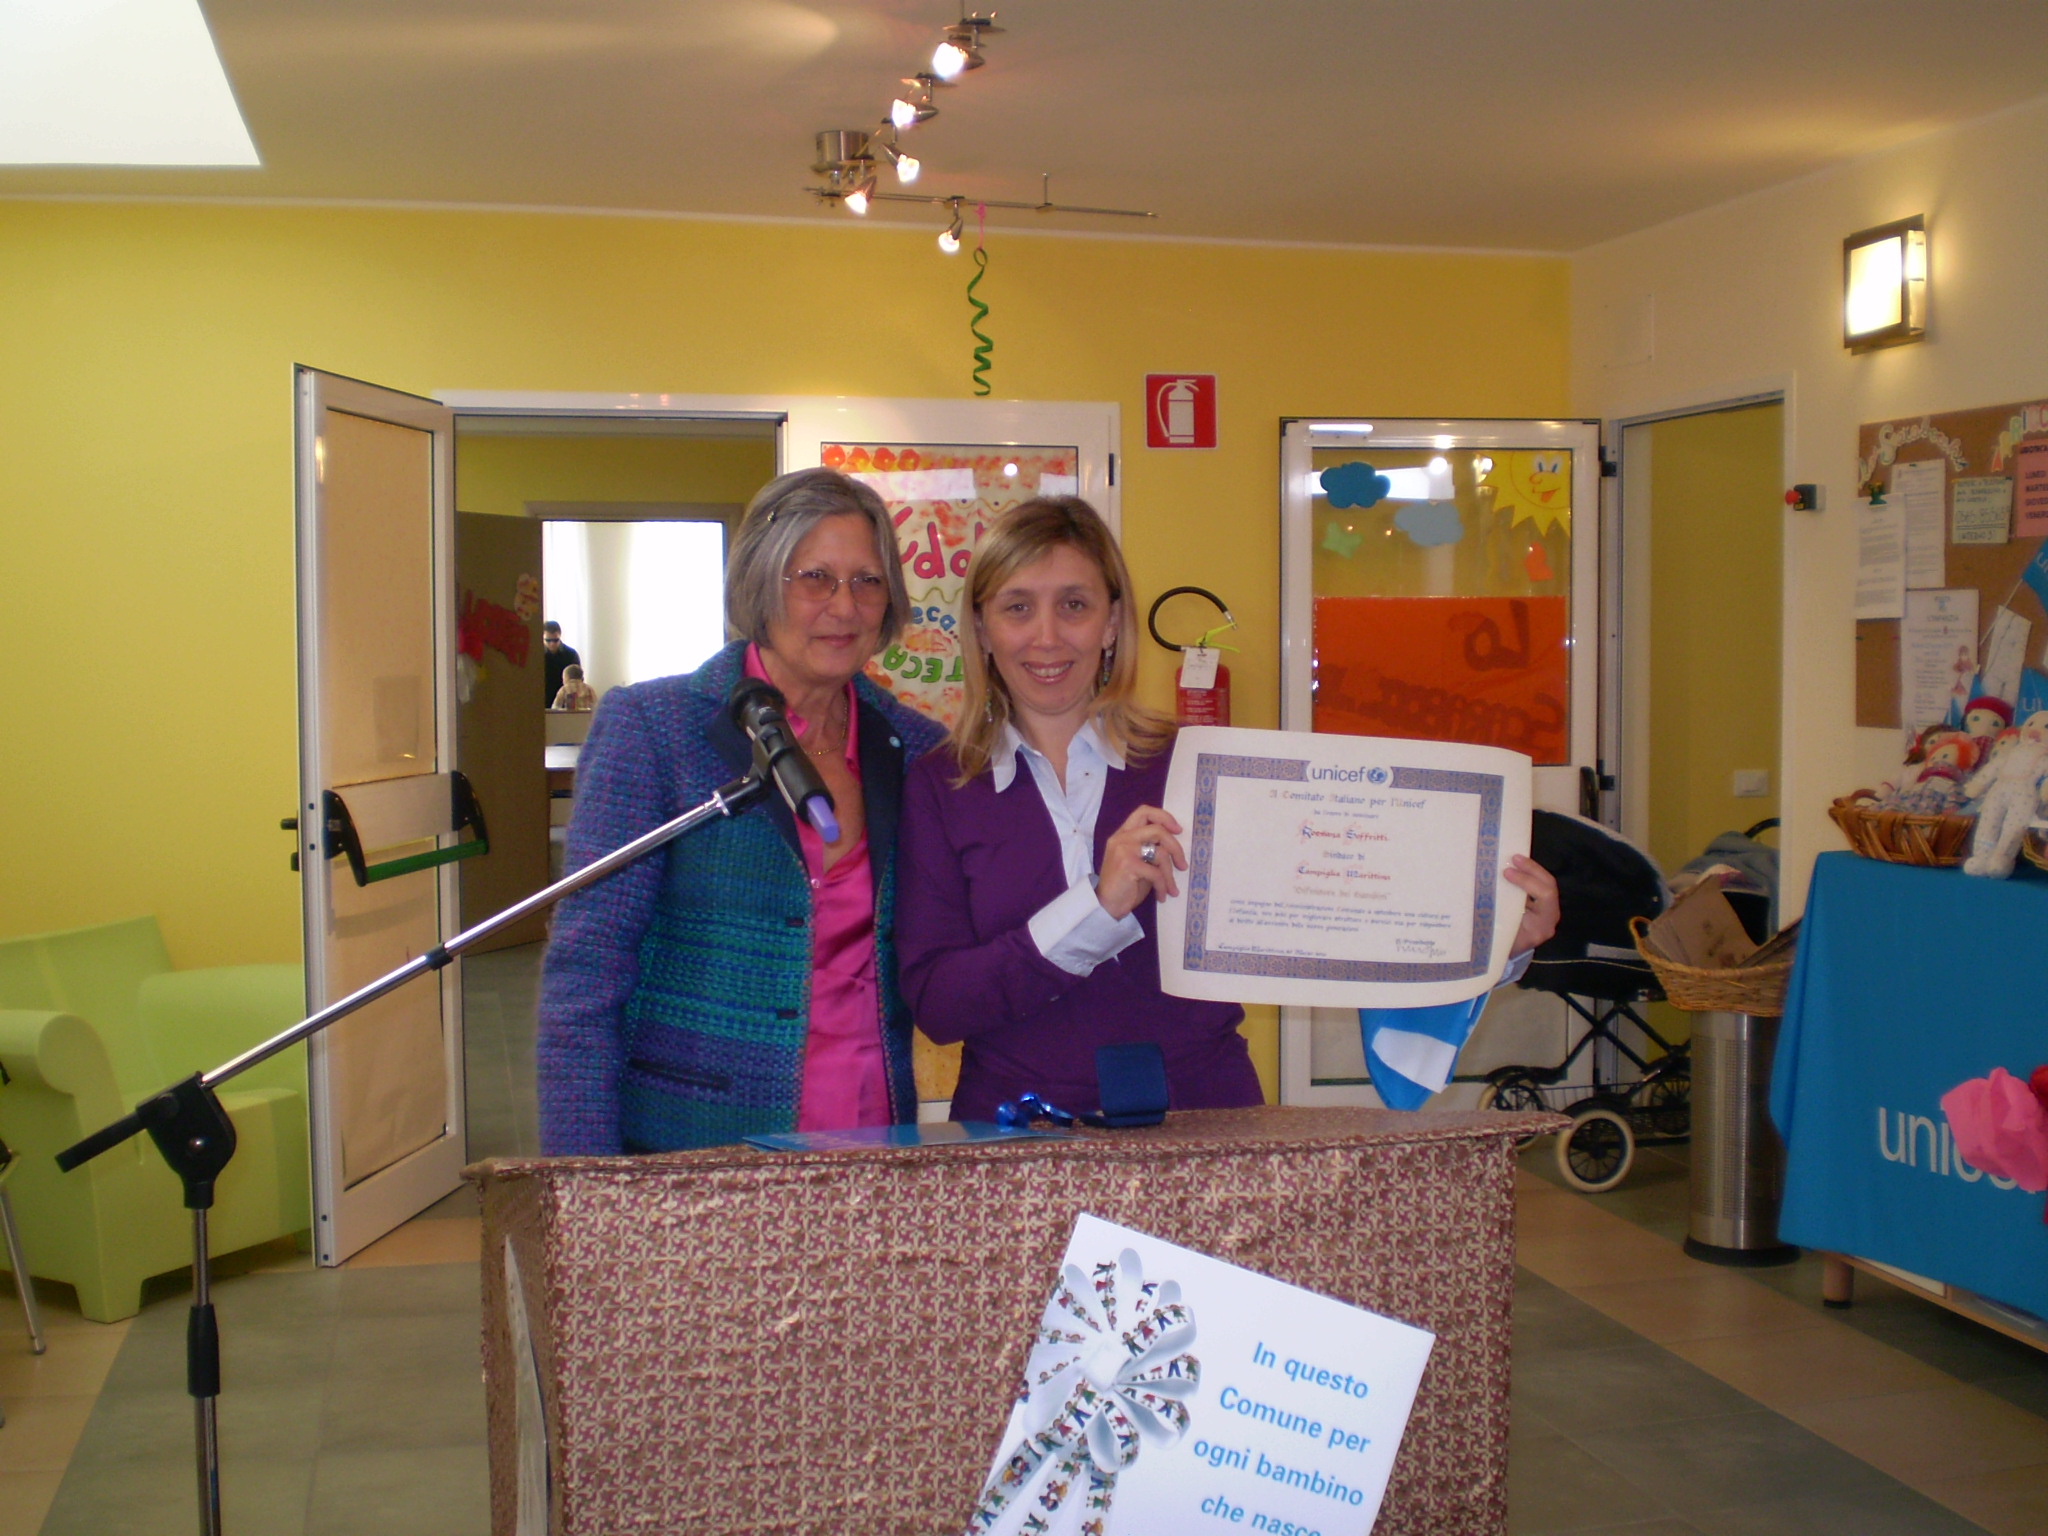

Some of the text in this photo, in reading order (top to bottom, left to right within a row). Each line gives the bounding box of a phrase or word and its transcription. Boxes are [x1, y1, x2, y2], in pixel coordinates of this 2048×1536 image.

[1311, 765, 1366, 783] unicef
[1369, 798, 1386, 808] per
[1252, 1341, 1369, 1399] In questo
[1219, 1386, 1371, 1453] Comune per
[1193, 1440, 1364, 1506] ogni bambino
[1200, 1496, 1245, 1523] che
